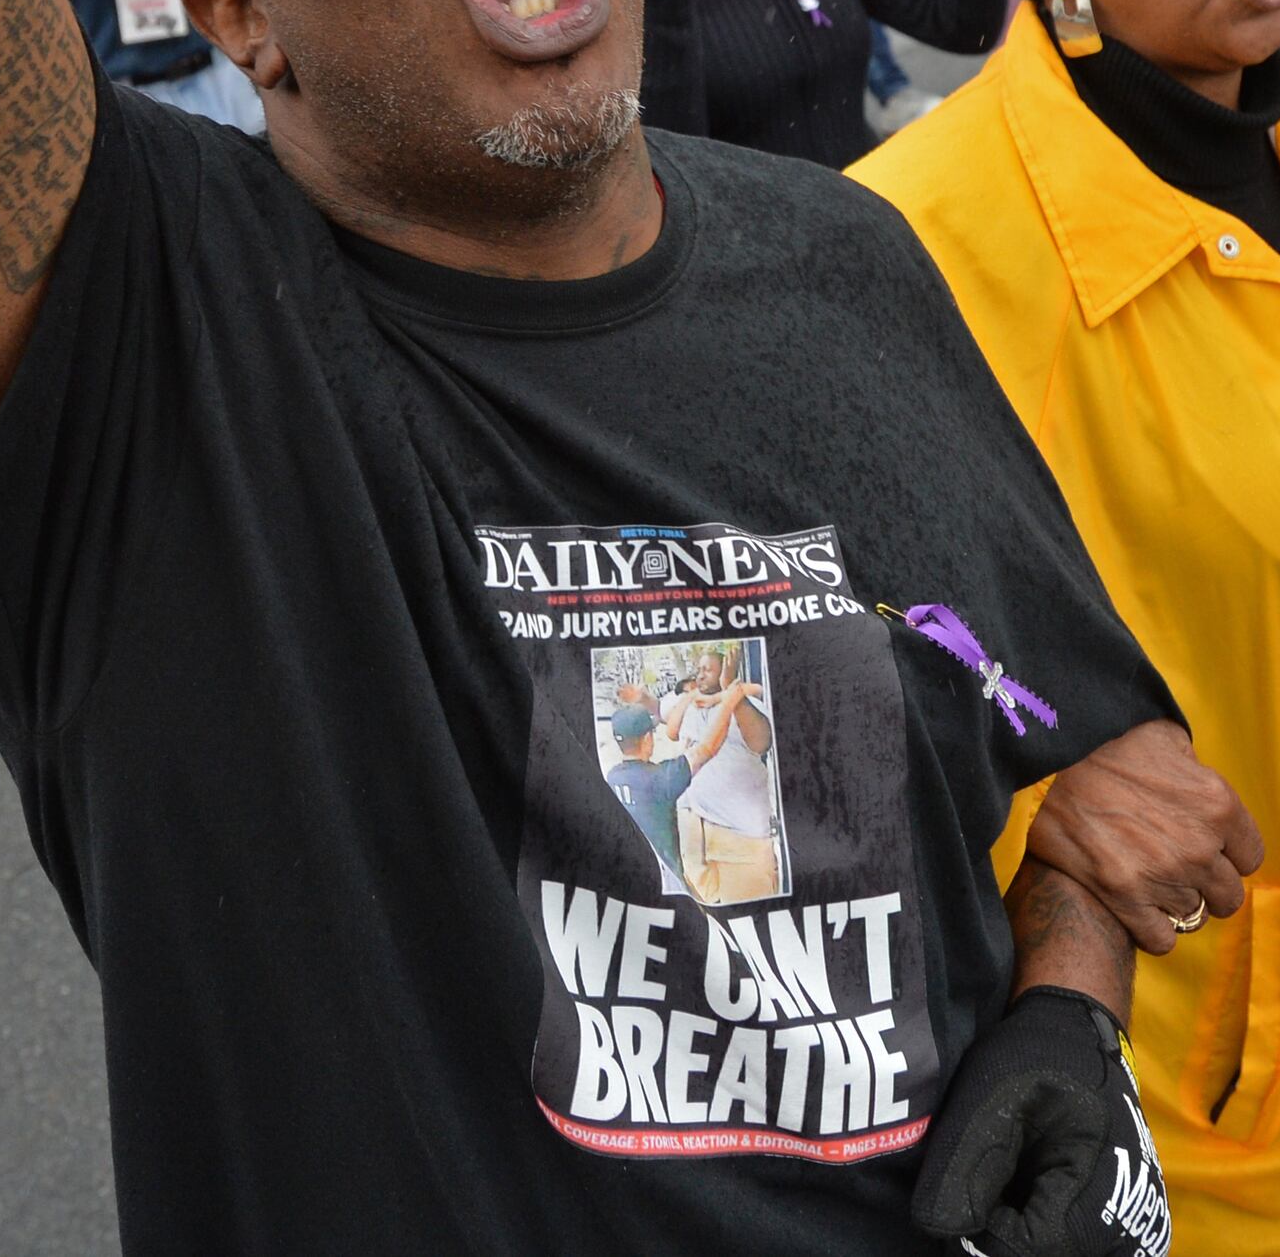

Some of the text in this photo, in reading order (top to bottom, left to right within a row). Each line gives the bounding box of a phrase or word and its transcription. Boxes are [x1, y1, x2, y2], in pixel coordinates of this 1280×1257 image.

[658, 527, 688, 540] FINAL
[477, 535, 843, 592] DAILY NEWS
[547, 594, 578, 607] NEW
[707, 581, 792, 601] NEWSPAPER
[559, 610, 623, 640] JURY
[625, 606, 721, 637] CLEARS
[726, 594, 824, 630] CHOKE
[540, 879, 902, 1023] WE CAN'T
[569, 1000, 910, 1134] BREATHE
[563, 1123, 639, 1150] COVERAGE:
[683, 1134, 739, 1151] REACTION
[740, 1135, 751, 1148] &
[754, 1136, 824, 1158] EDITORIAL
[842, 1138, 877, 1157] PAGES
